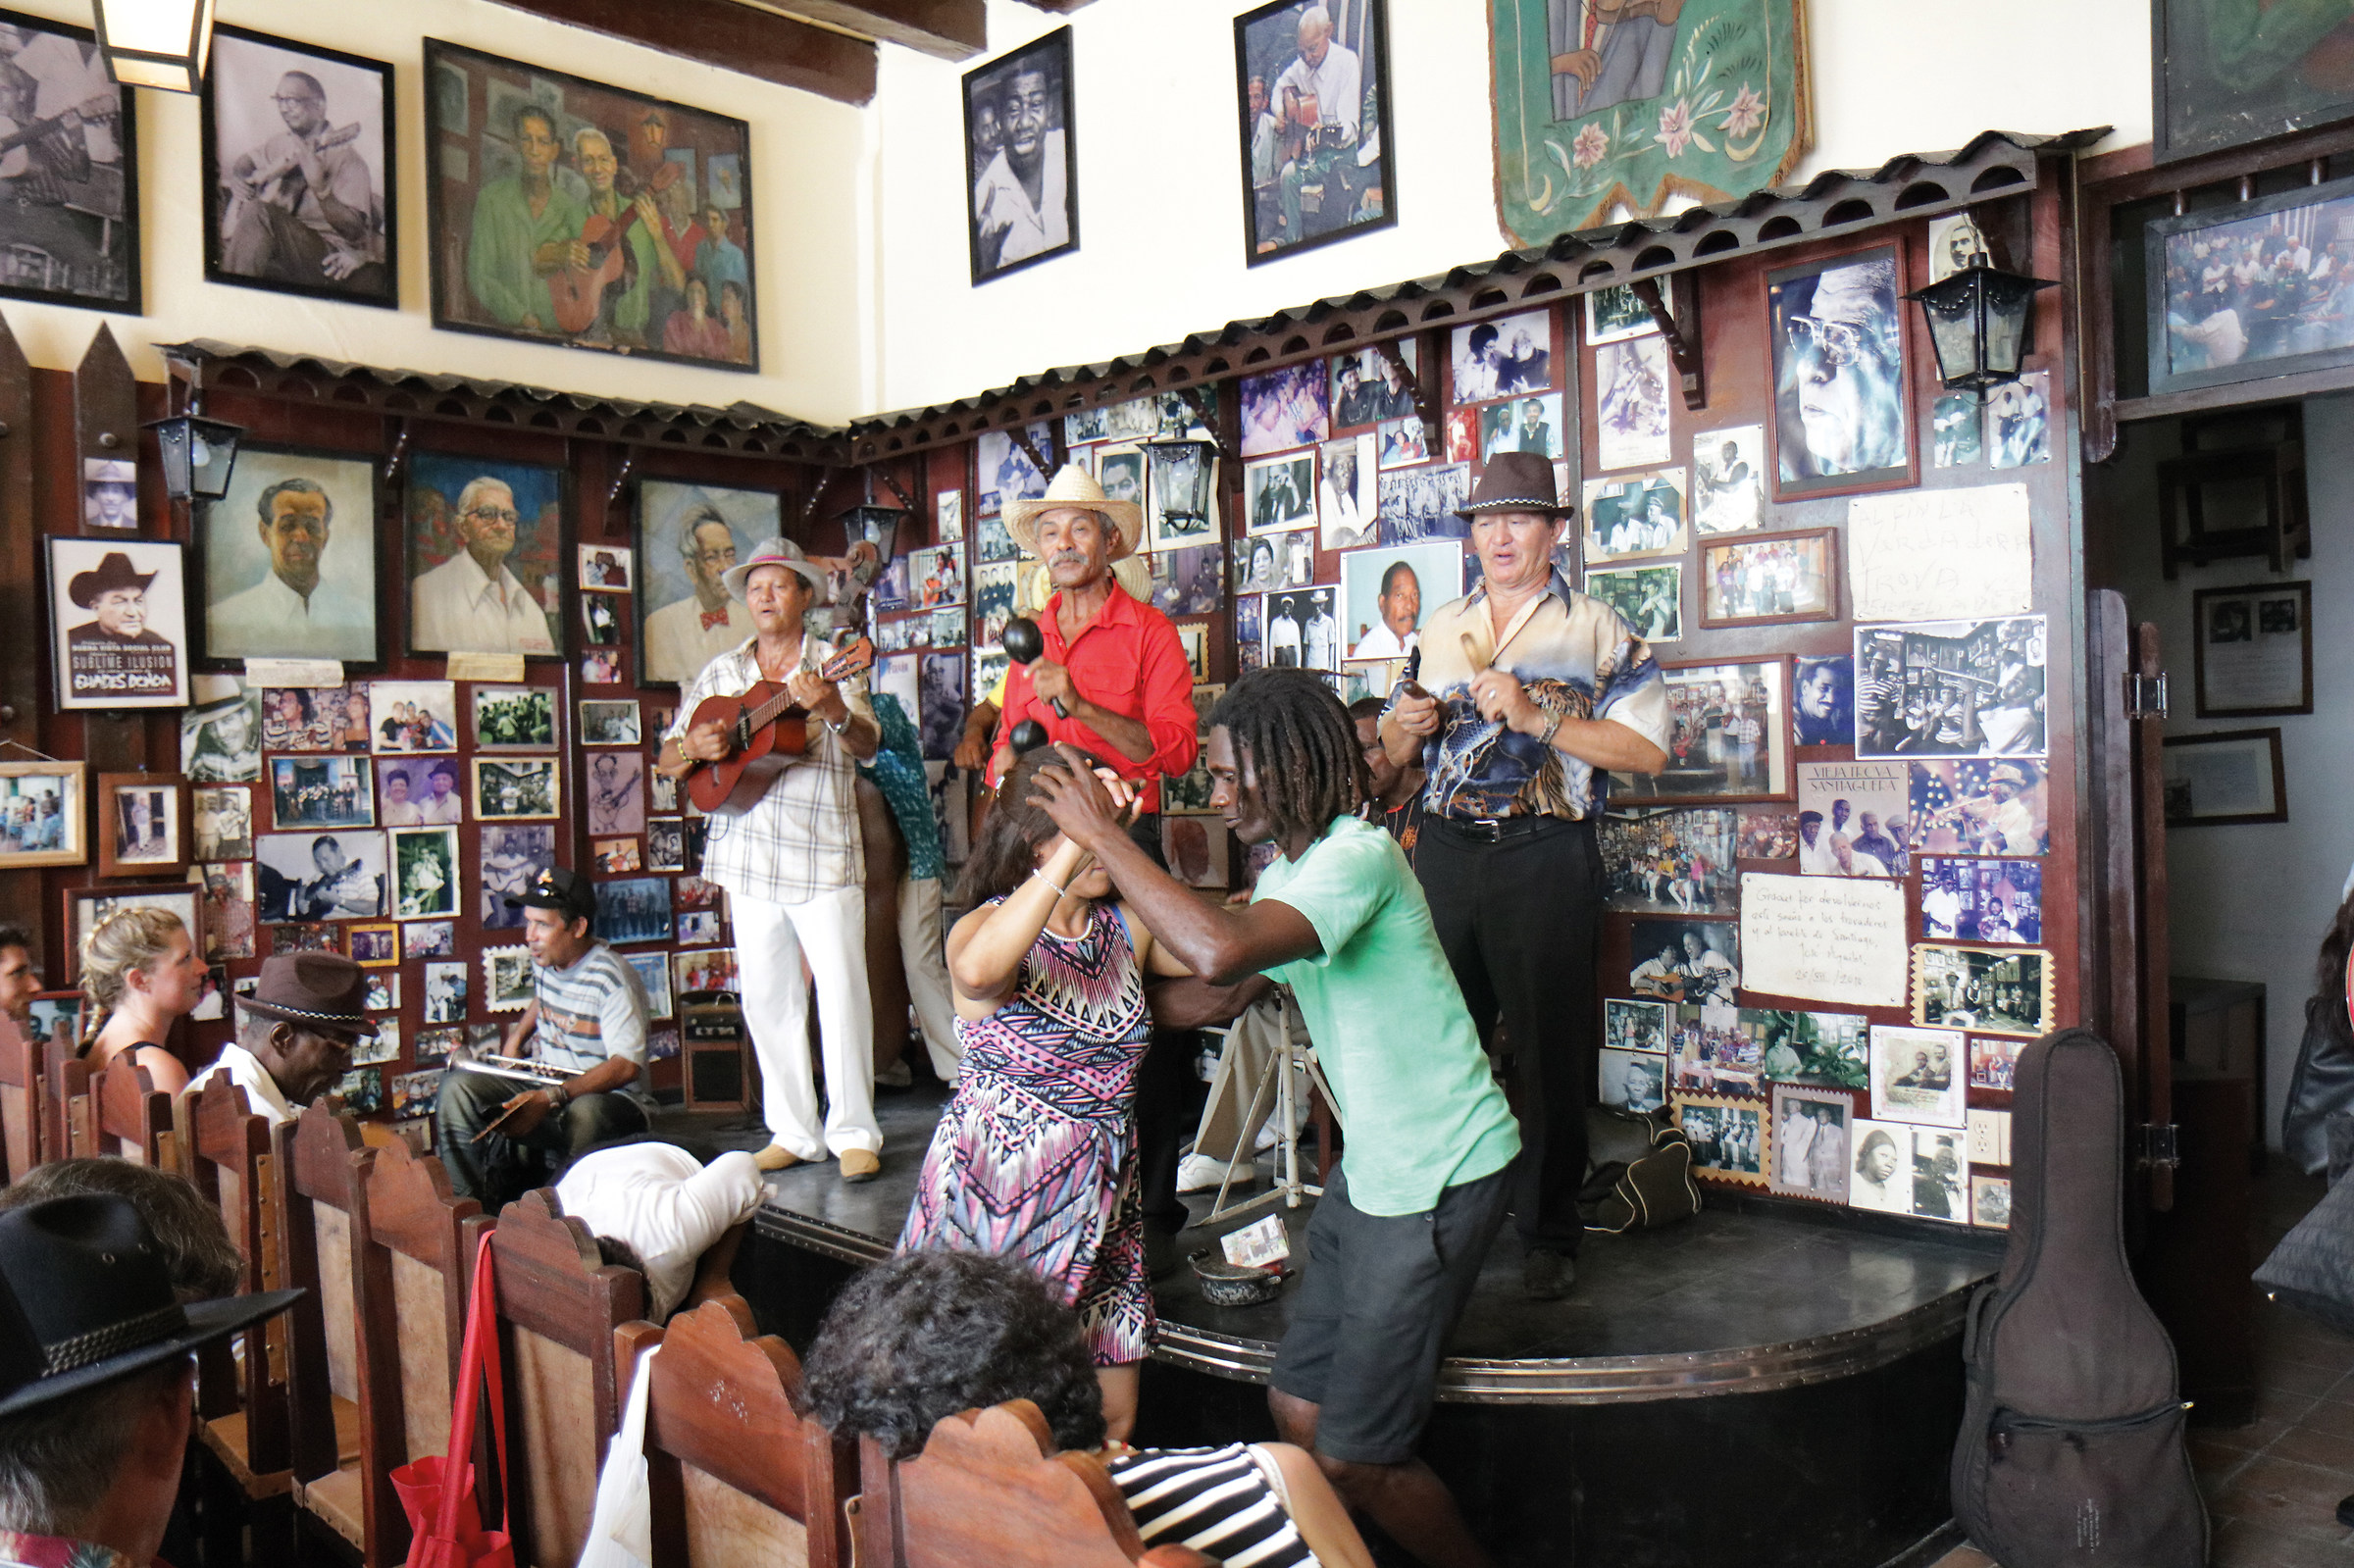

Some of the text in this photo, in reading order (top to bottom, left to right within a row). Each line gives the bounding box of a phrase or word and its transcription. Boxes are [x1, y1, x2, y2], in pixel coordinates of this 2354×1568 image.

[73, 655, 123, 669] SUBLIME
[1814, 766, 1892, 778] VIEJA TROVA
[1811, 781, 1896, 792] SANTIAGUERA
